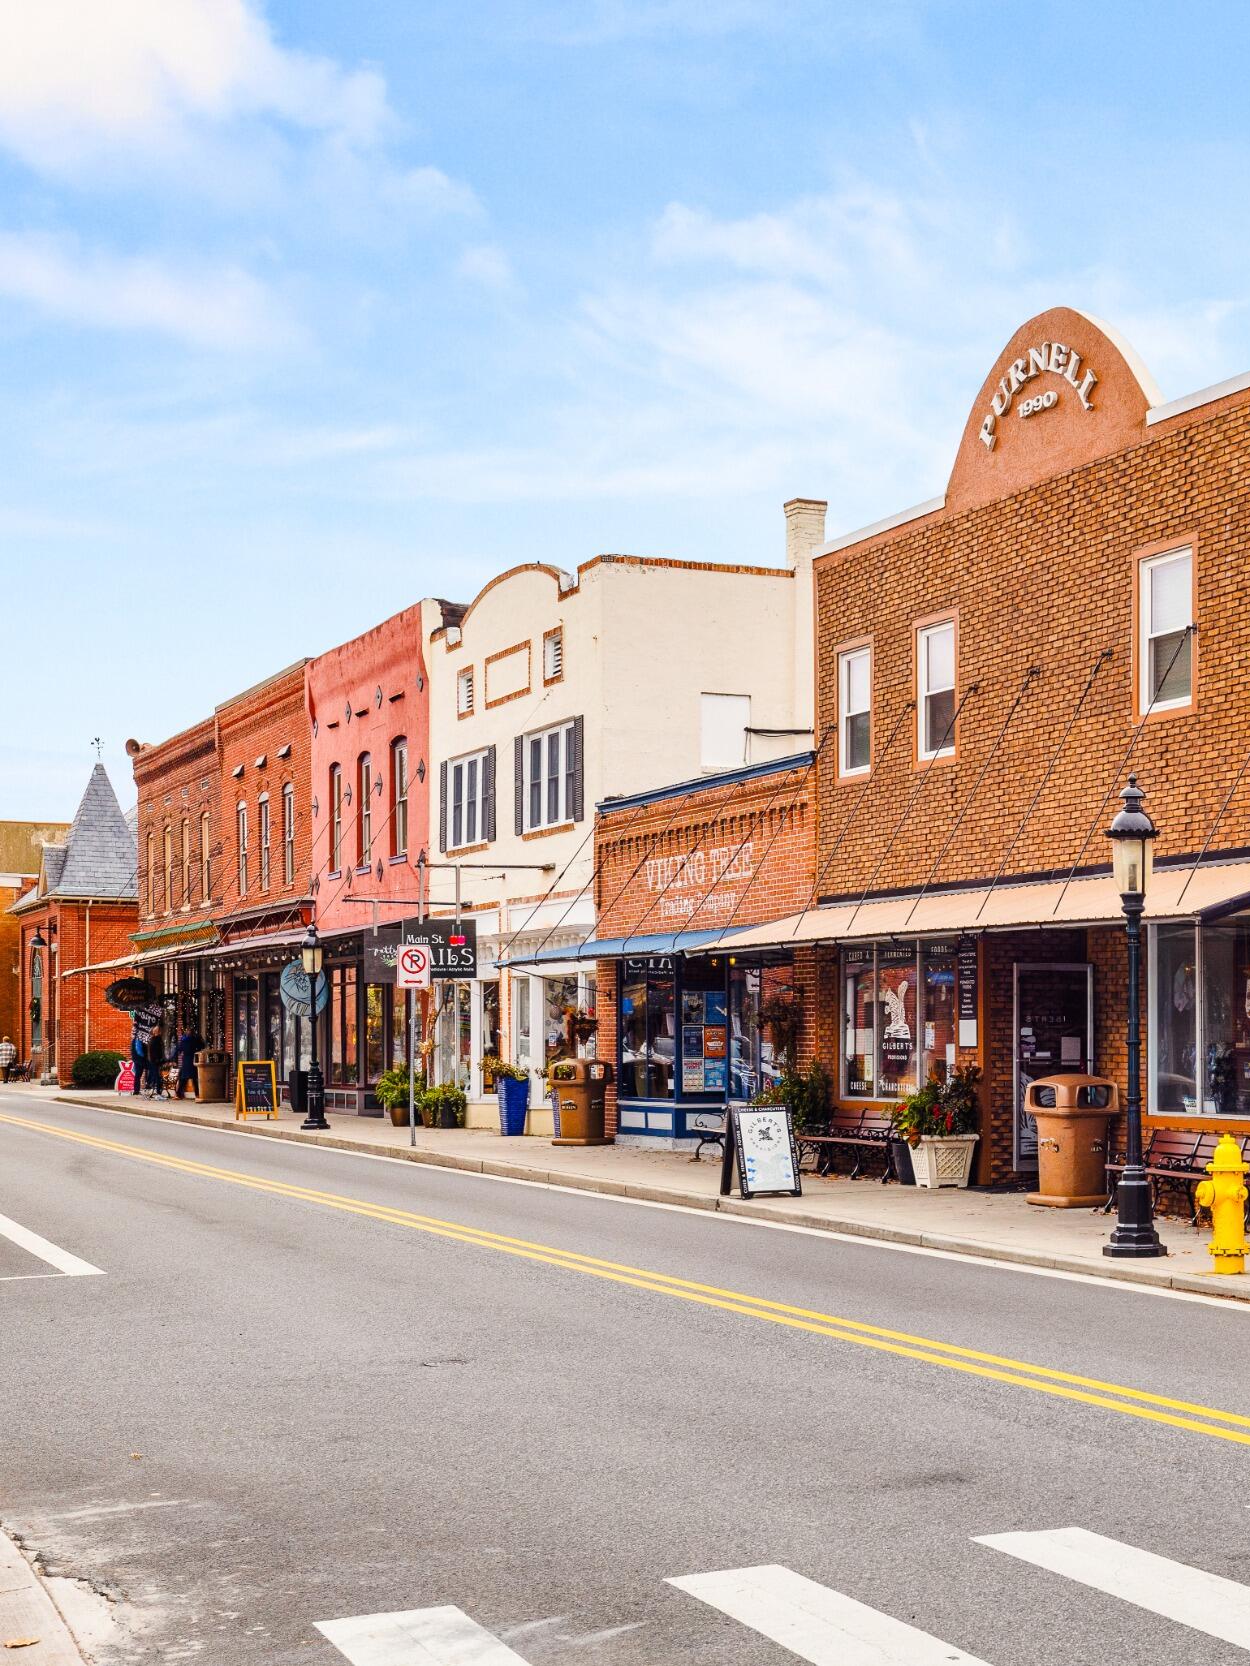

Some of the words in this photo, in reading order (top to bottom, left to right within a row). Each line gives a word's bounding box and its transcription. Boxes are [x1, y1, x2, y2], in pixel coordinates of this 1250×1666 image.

[979, 341, 1098, 452] PURNELL
[1017, 391, 1058, 418] 1990
[710, 843, 753, 883] TREE
[406, 934, 429, 945] Main
[431, 934, 444, 944] St.
[882, 1042, 913, 1050] GILBERT'S
[850, 1081, 867, 1091] CHEESE
